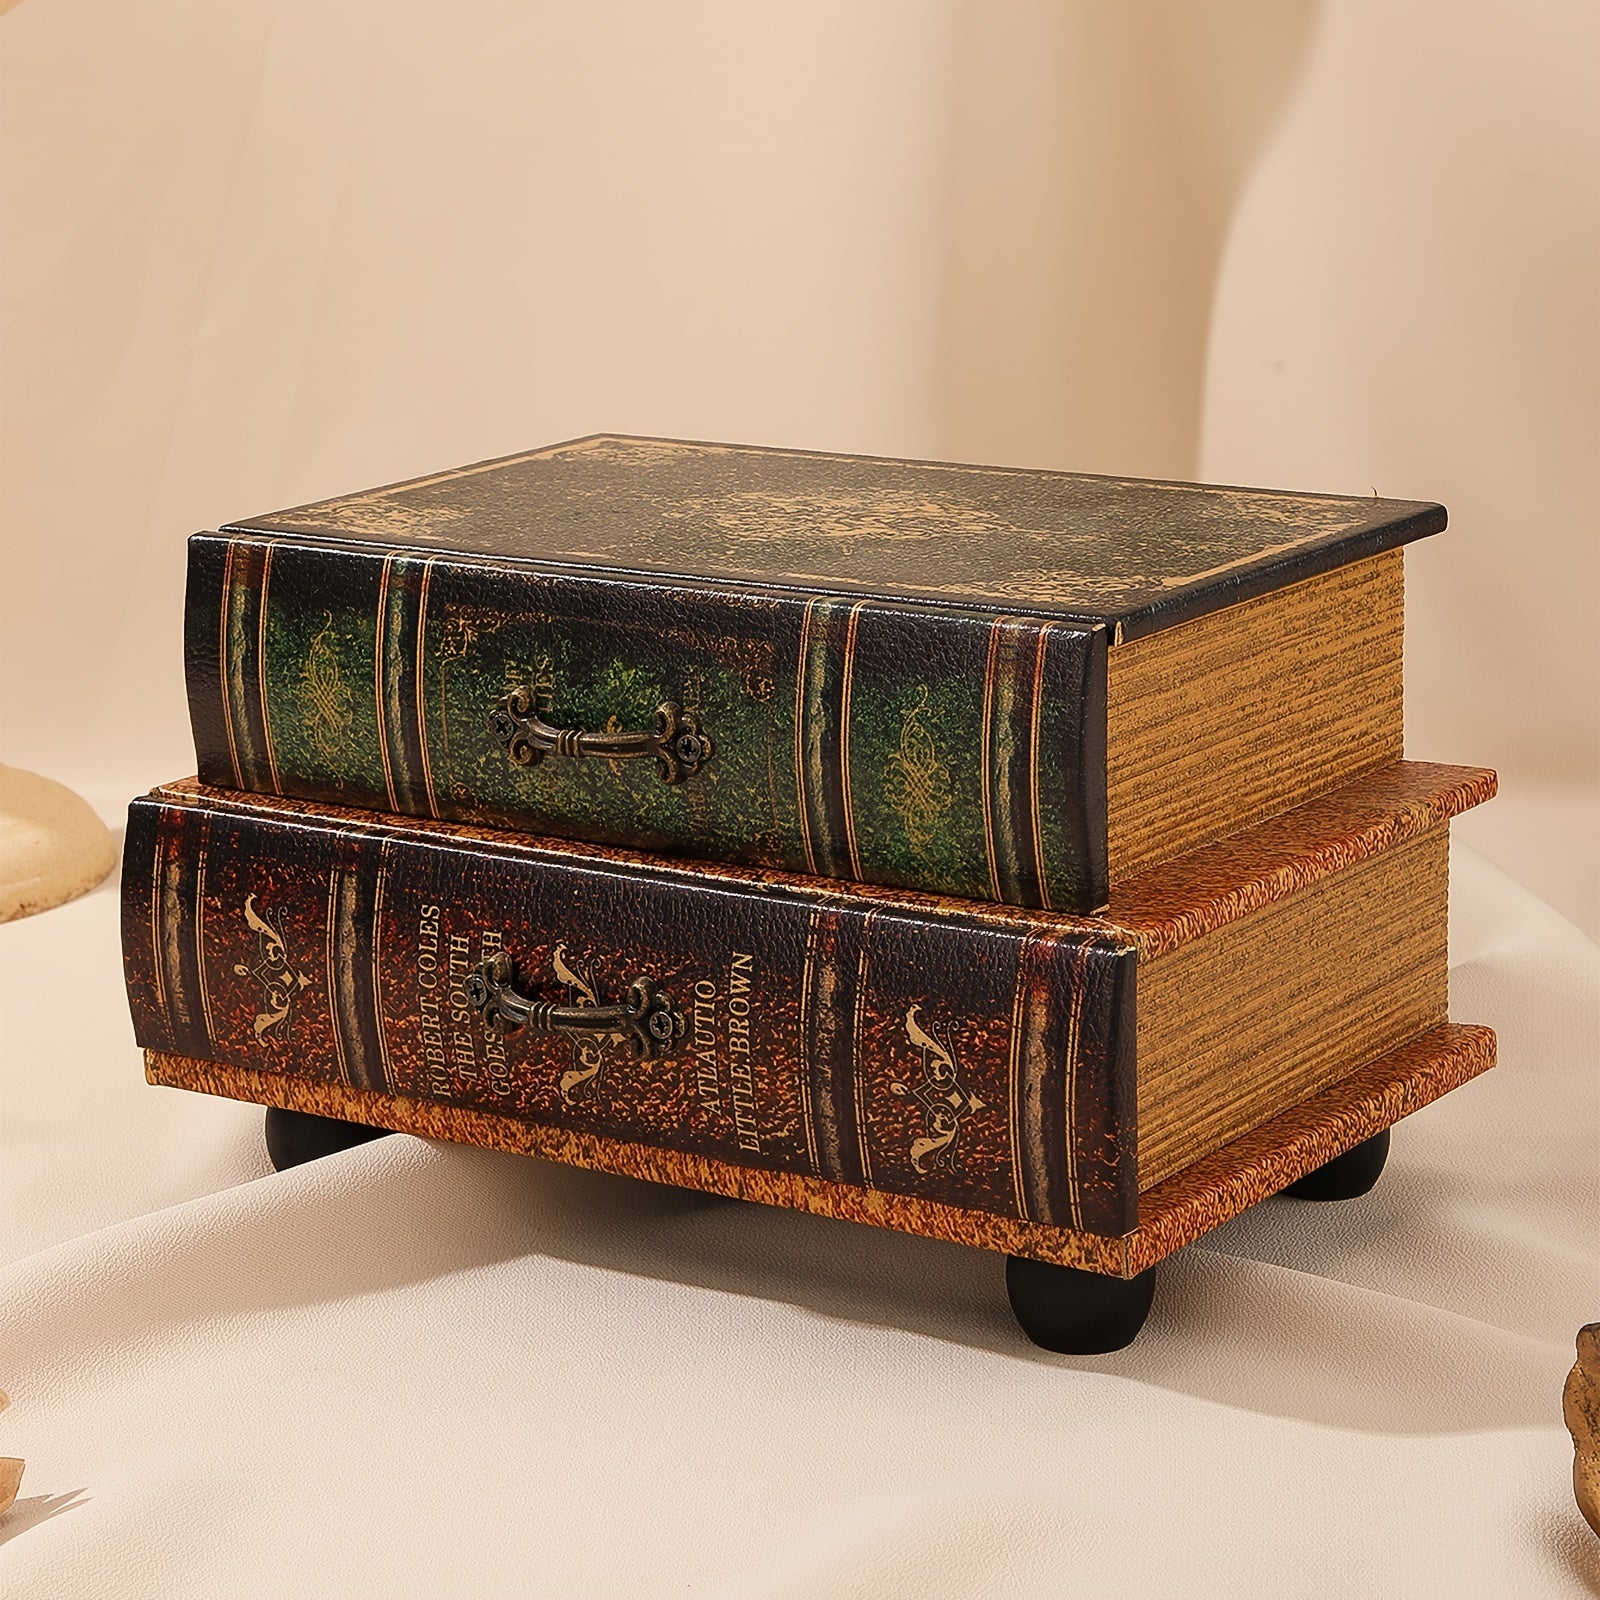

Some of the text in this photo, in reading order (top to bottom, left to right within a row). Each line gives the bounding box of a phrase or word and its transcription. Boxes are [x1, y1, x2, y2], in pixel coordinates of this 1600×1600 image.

[418, 904, 451, 1097] ROBERT COLES
[450, 935, 478, 1080] THE SOUTH
[694, 979, 721, 1116] ATLAUTIO
